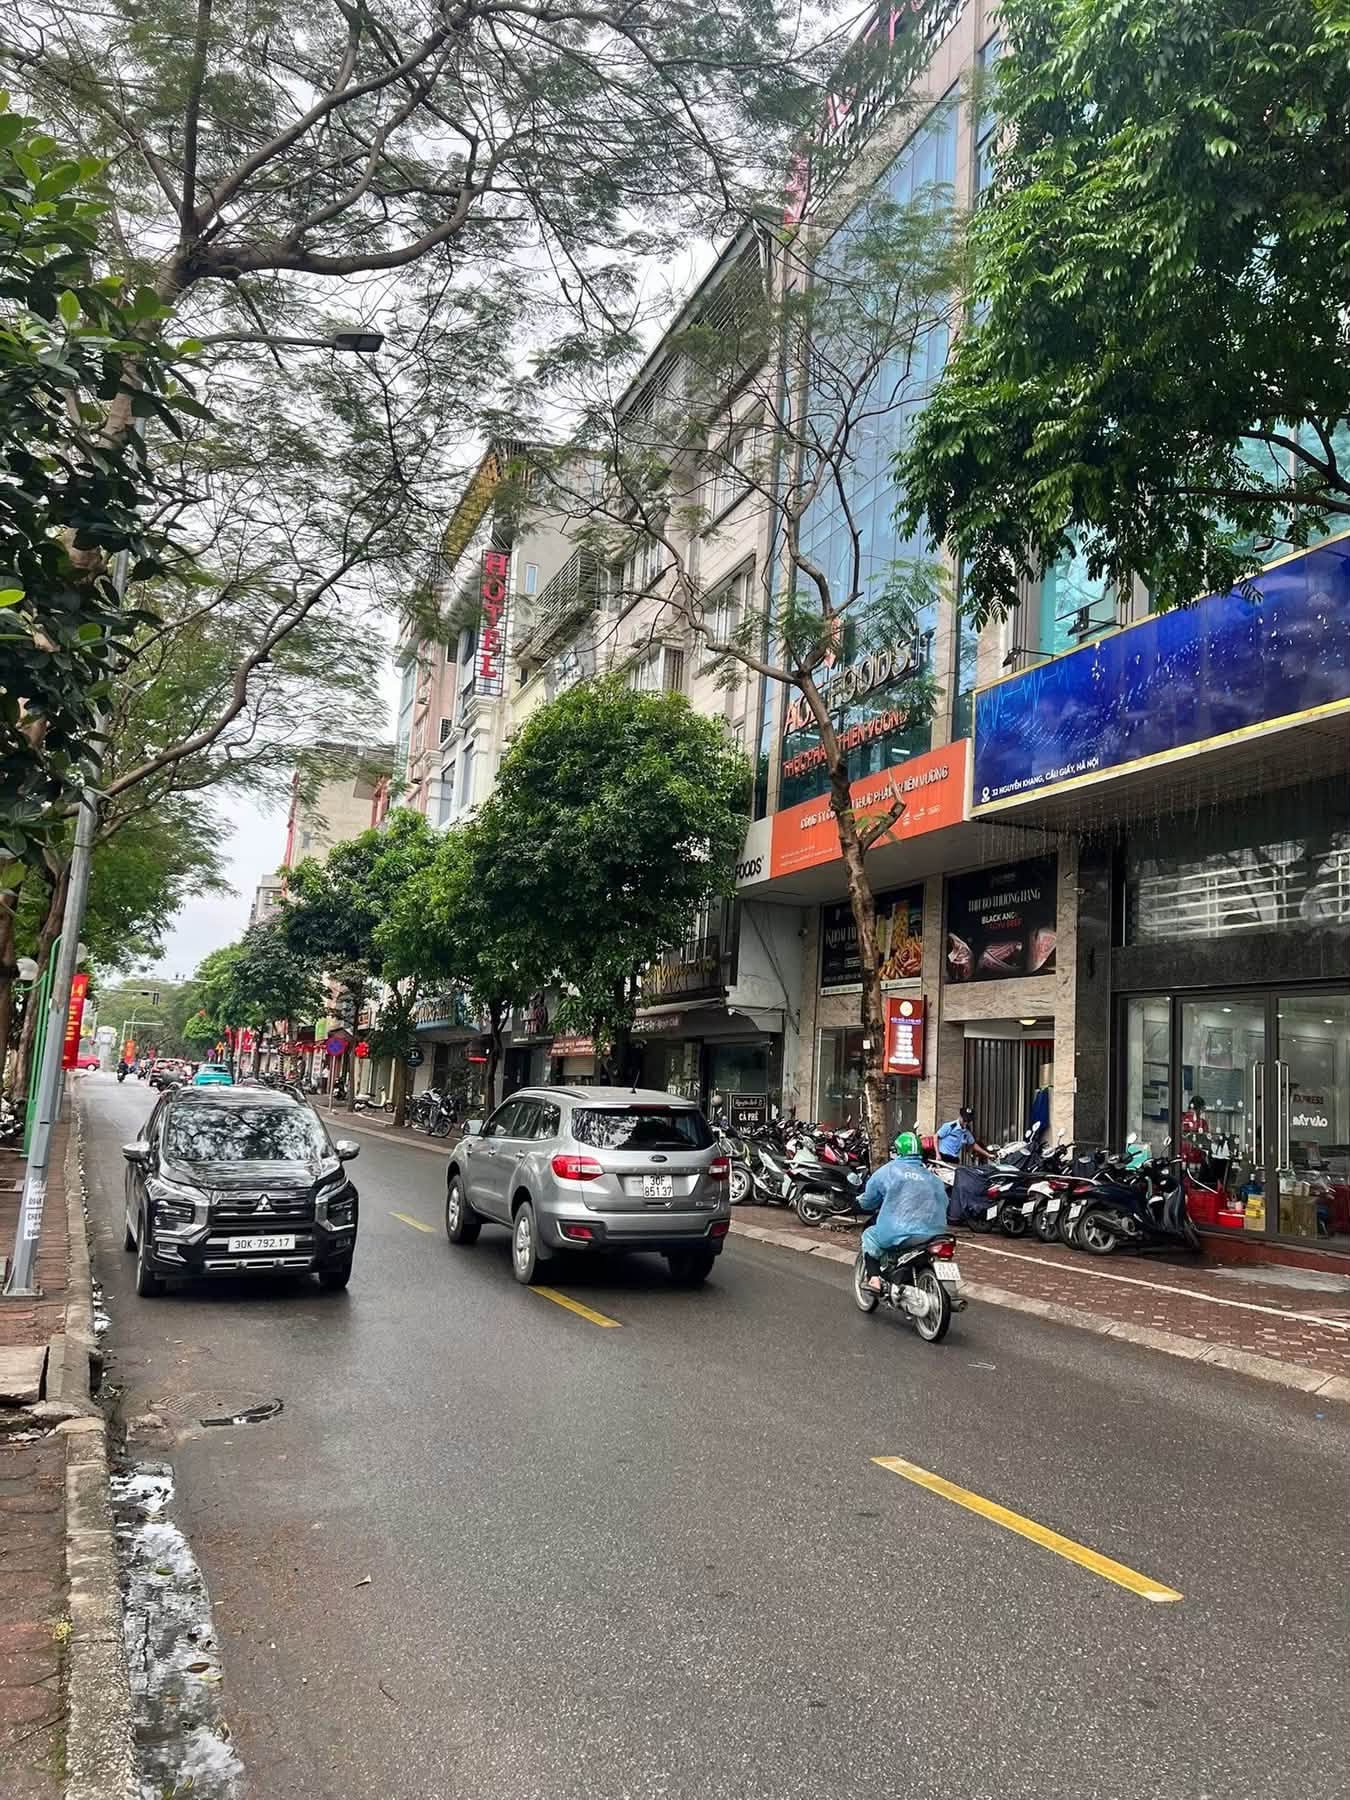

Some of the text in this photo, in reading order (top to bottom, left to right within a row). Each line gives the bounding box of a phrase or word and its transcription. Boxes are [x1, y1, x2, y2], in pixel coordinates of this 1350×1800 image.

[482, 551, 508, 678] HOTEL
[827, 639, 910, 710] FOODS
[991, 788, 999, 796] 32
[999, 778, 1022, 795] NGUYỄN
[1022, 774, 1044, 787] KHANG,
[1076, 759, 1086, 771] HÀ
[1086, 756, 1100, 769] NỘI
[735, 857, 762, 879] FOODS
[981, 912, 1001, 925] BLACK
[650, 1175, 665, 1186] 30F
